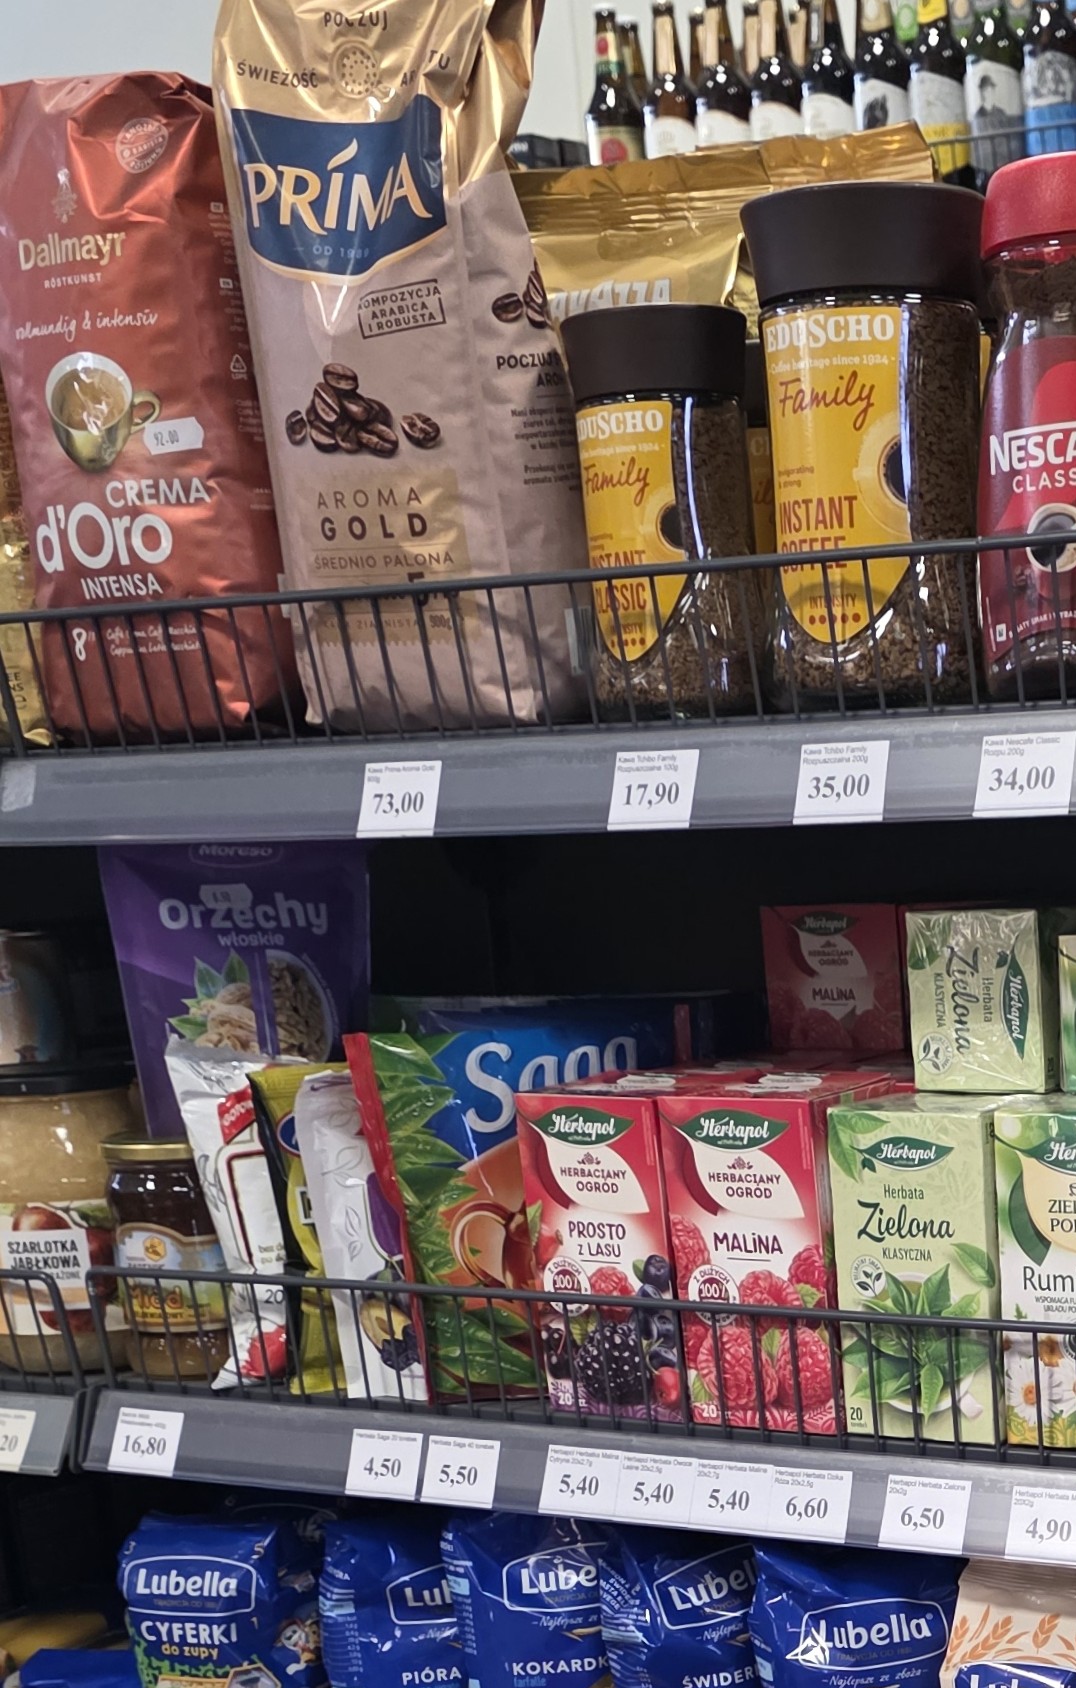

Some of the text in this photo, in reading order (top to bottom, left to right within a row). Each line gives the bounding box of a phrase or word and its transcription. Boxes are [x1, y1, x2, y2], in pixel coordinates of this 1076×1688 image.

[323, 9, 389, 30] POCZUJ
[236, 59, 319, 89] ŚWIEŻOŚĆ
[18, 230, 127, 271] Dallmayr
[96, 309, 158, 328] intensiv
[370, 299, 429, 323] ARABICA
[375, 310, 438, 332] ROBUSTA
[766, 314, 895, 352] EDUSCHO
[779, 370, 875, 431] Family
[105, 477, 212, 508] CREMA
[584, 456, 650, 506] Family
[316, 487, 423, 509] AROMA
[779, 495, 858, 534] INSTANT
[35, 501, 173, 573] d'Oro
[321, 512, 428, 542] GOLD
[314, 550, 455, 570] ŚREDNIO PALONA
[81, 573, 164, 600] INTENSA
[807, 774, 870, 802] 35,00
[988, 766, 1055, 795] 34,00
[372, 791, 425, 819] 73,00
[623, 782, 679, 809] 17,90
[158, 891, 328, 935] Orzechy
[217, 932, 284, 947] włoskie
[946, 945, 982, 1056] Zielona
[548, 1113, 616, 1136] Herbapol
[695, 1115, 770, 1140] Herbapol
[880, 1140, 936, 1163] Herbapol
[560, 1166, 627, 1181] HERBACIANY
[576, 1178, 619, 1194] OGRÓD
[883, 1185, 924, 1201] Herbata
[568, 1221, 626, 1240] PROSTO
[856, 1200, 955, 1242] Zielona
[8, 1240, 78, 1254] SZARLOTKA
[587, 1241, 622, 1258] LASU
[882, 1247, 932, 1263] KLASYCZNA
[11, 1255, 80, 1271] JABŁKOWA
[122, 1435, 167, 1456] 16,80
[363, 1457, 402, 1479] 4,50
[438, 1464, 479, 1489] 5,50
[559, 1474, 599, 1498] 5,40
[632, 1482, 674, 1505] 5,40
[707, 1488, 750, 1512] 5,40
[786, 1496, 828, 1520] 6,60
[900, 1506, 945, 1531] 6,50
[1025, 1516, 1072, 1546] 4,90
[136, 1568, 238, 1598] Lubella
[140, 1620, 238, 1644] CYFERKI
[817, 1614, 932, 1651] Lubella
[162, 1644, 219, 1661] do zupy
[402, 1666, 462, 1686] PIÓRA
[514, 1675, 546, 1688] farfalle
